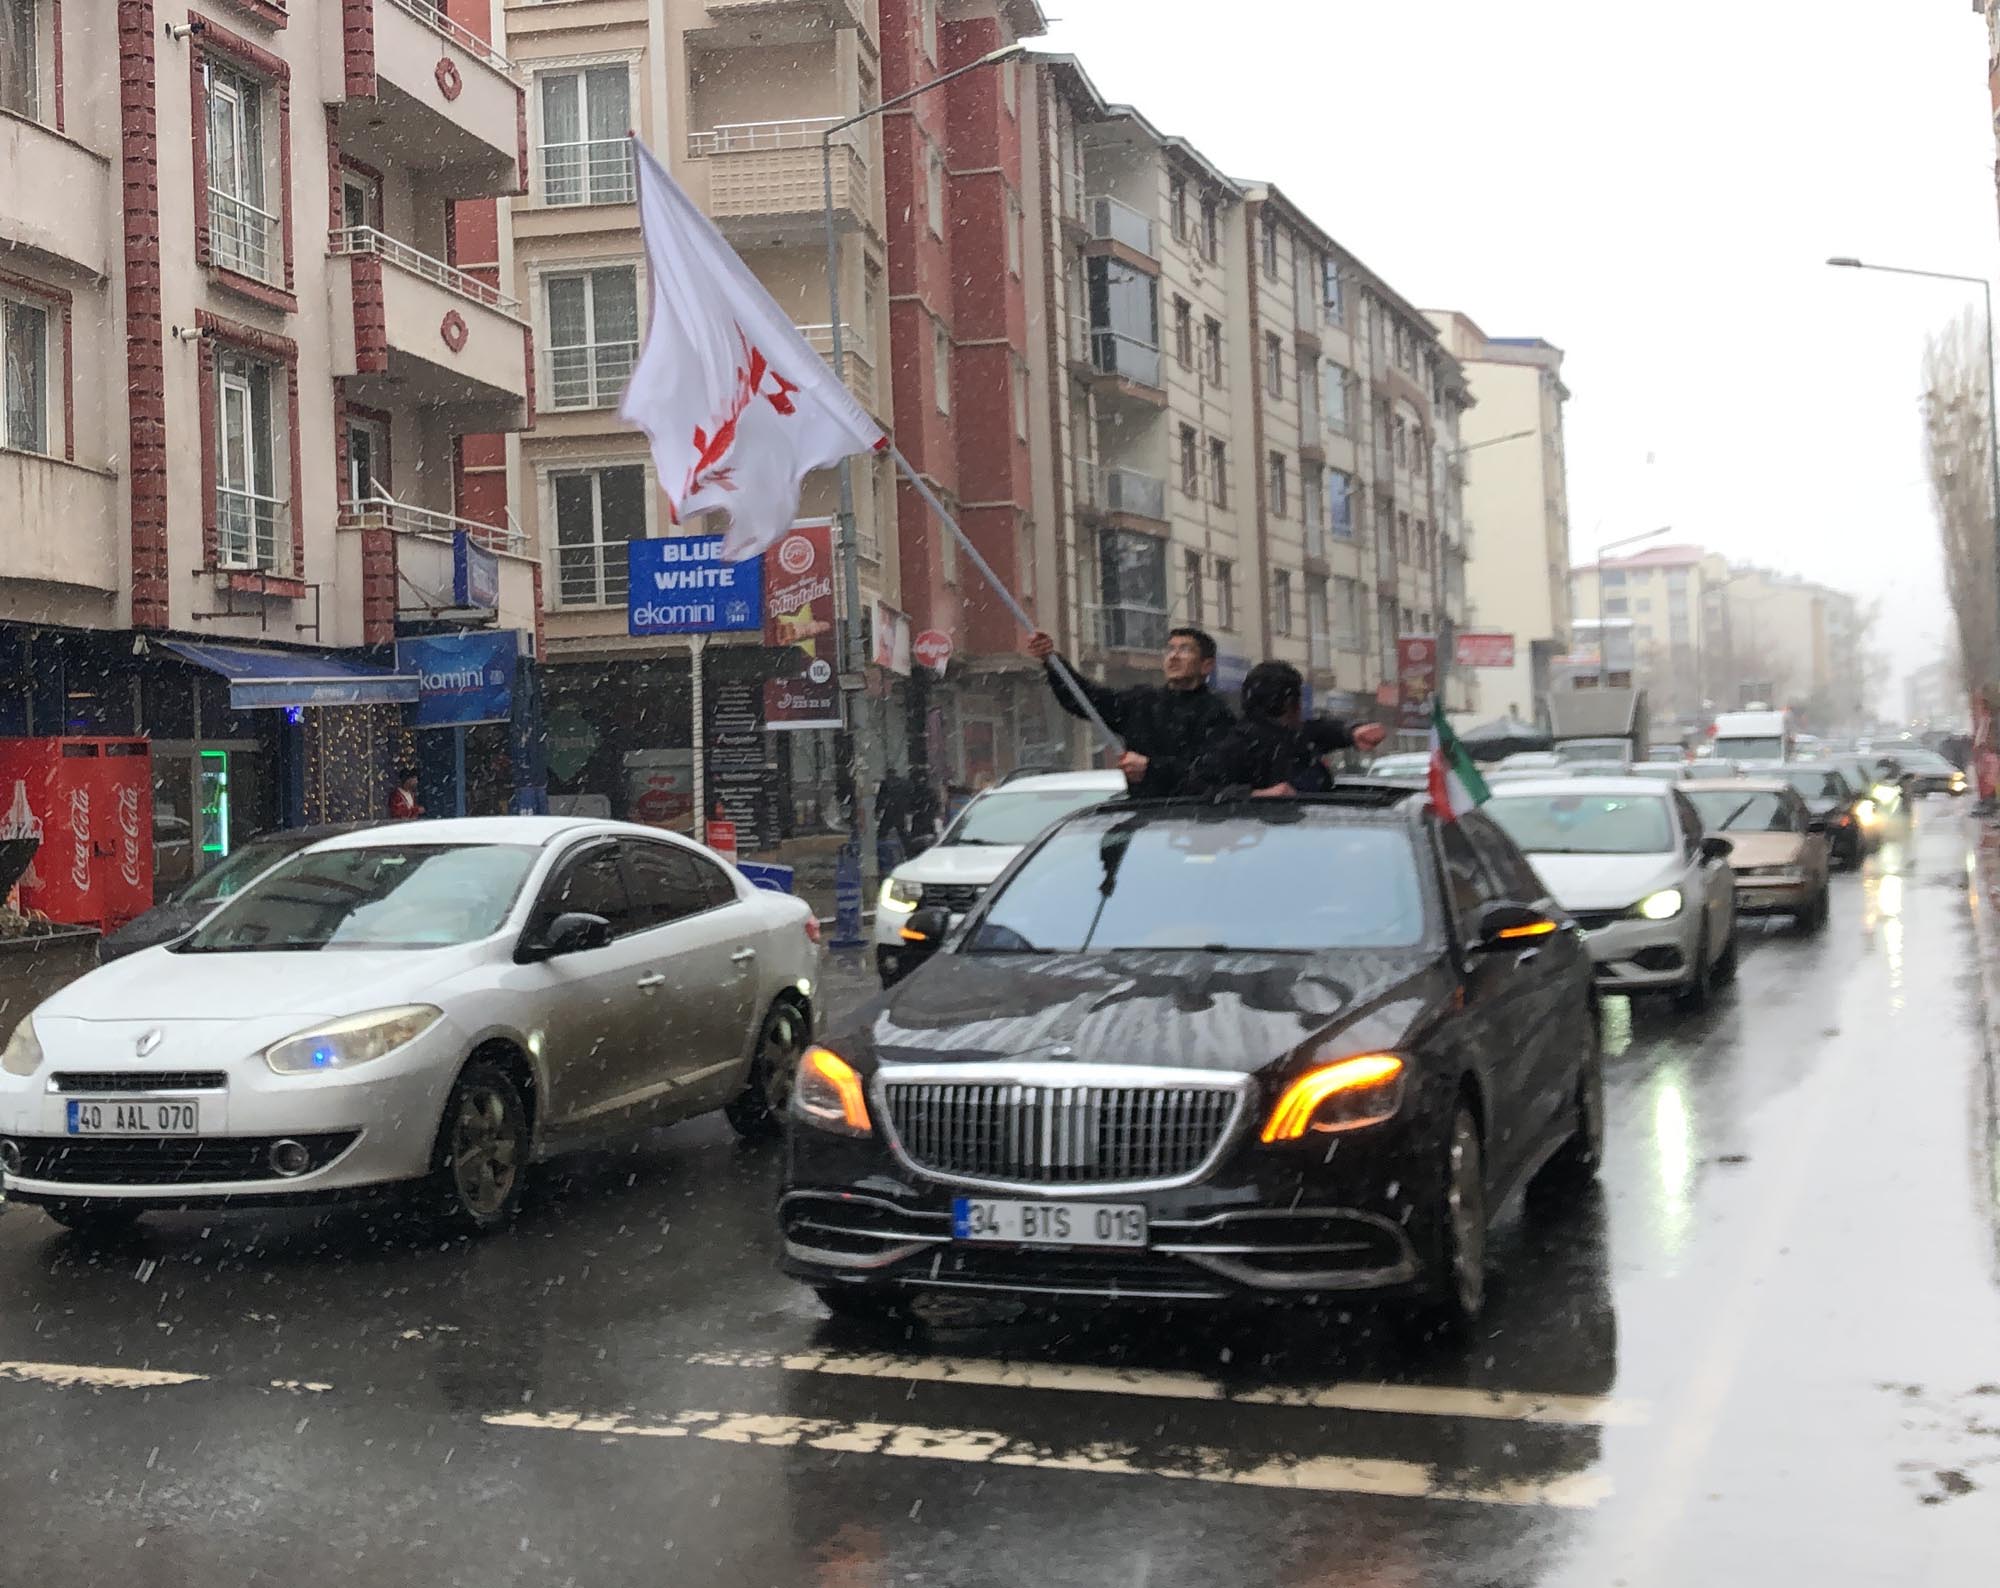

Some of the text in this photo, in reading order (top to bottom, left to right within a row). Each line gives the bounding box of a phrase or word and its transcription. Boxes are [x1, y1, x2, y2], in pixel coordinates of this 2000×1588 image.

[663, 541, 724, 563] BLUE
[633, 598, 715, 625] ekomini
[419, 665, 484, 693] komini
[81, 1105, 193, 1130] 40 AAL 070
[970, 1204, 1000, 1235] 34
[1022, 1206, 1071, 1238] BTS
